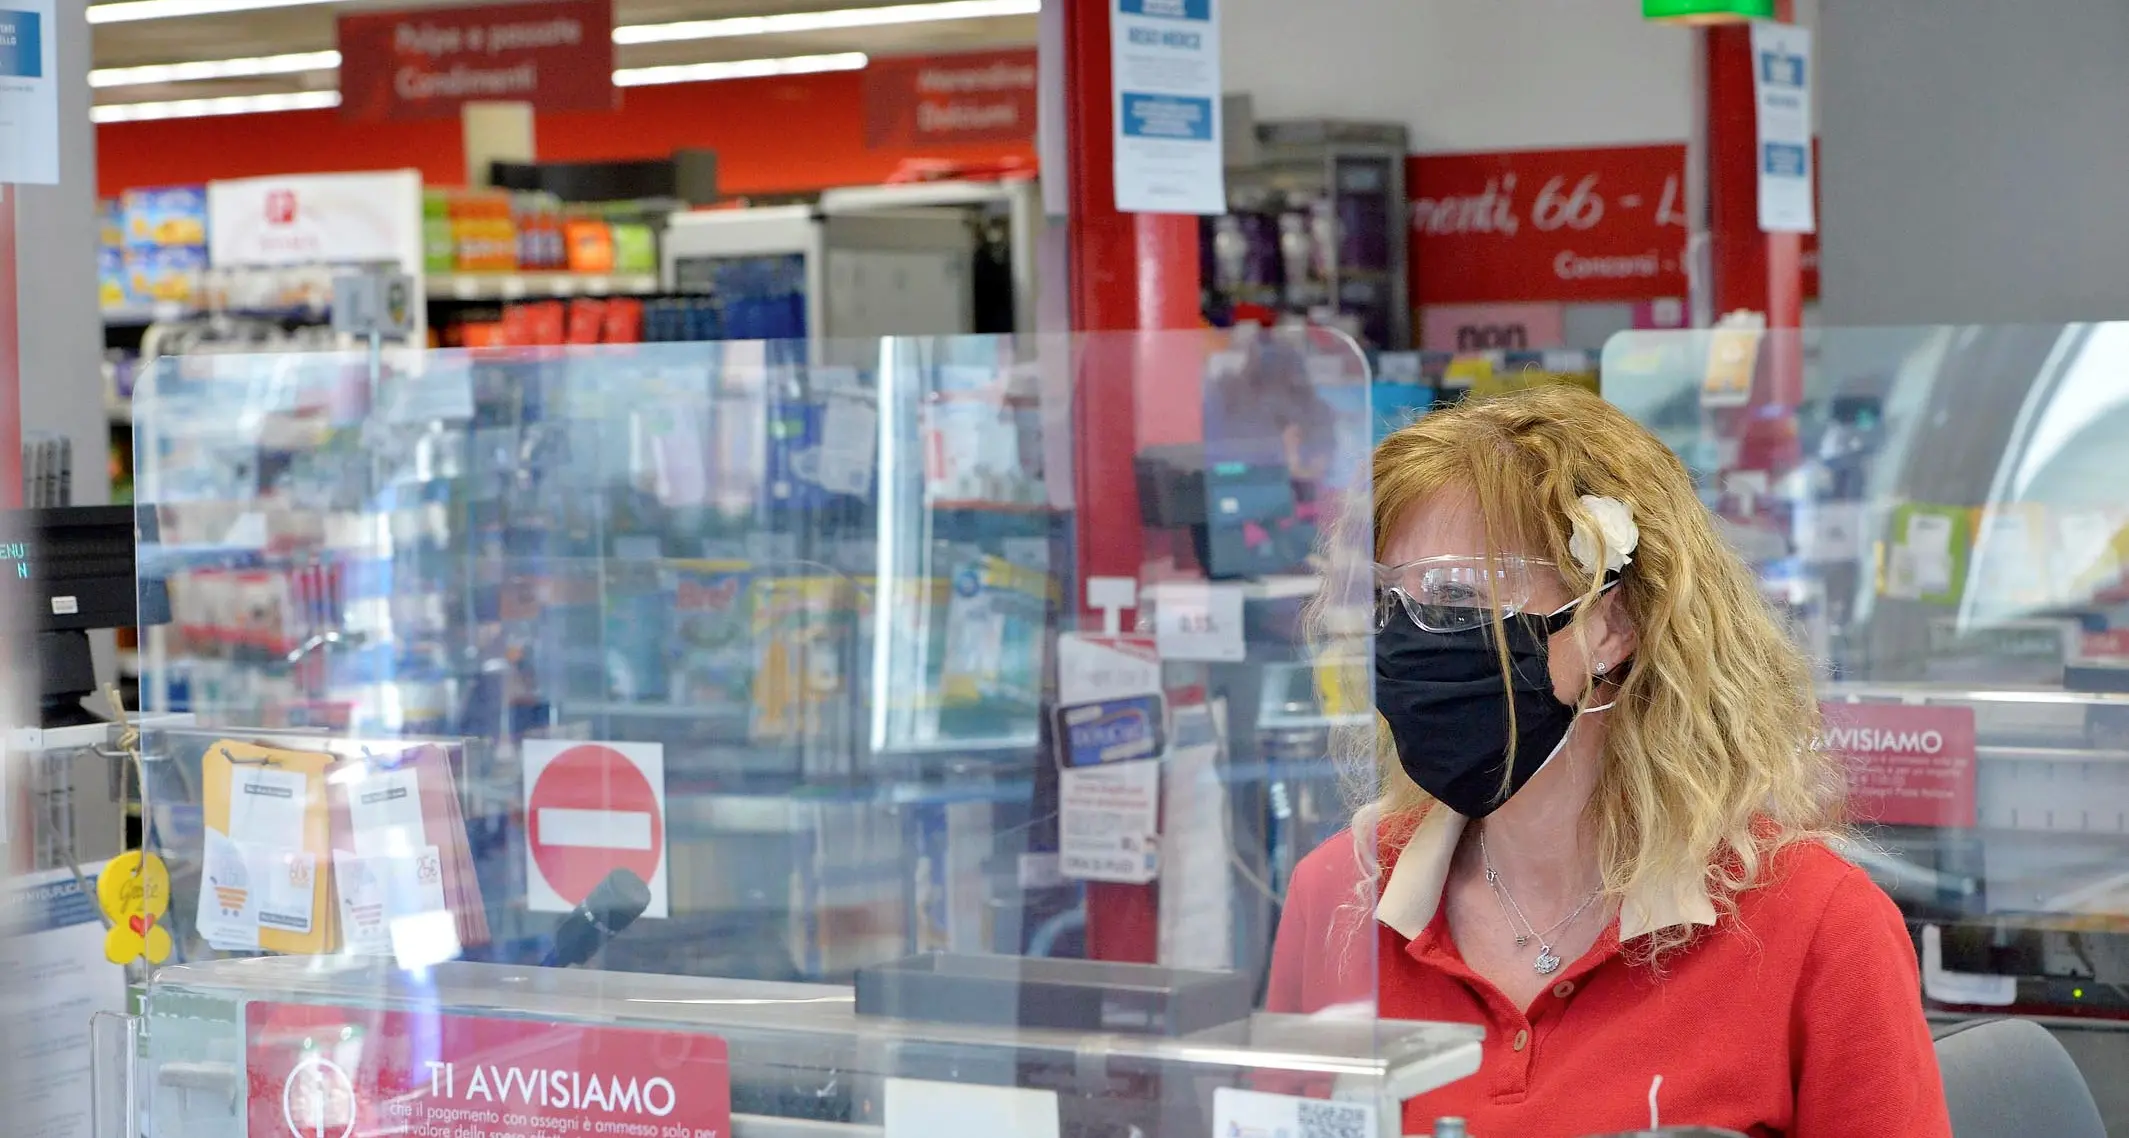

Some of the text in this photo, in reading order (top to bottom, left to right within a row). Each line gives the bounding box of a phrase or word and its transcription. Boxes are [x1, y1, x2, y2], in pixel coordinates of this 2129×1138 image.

[1531, 174, 1604, 232] 66
[1813, 726, 1943, 754] VVISIAMO
[425, 1060, 676, 1117] TI AVVISIAMO
[389, 1100, 413, 1117] che
[416, 1103, 423, 1117] il
[427, 1106, 499, 1123] pagamento
[503, 1112, 527, 1126] con
[530, 1114, 579, 1133] assegni
[595, 1122, 658, 1137] ammesso
[662, 1122, 689, 1138] solo
[694, 1128, 717, 1138] per
[401, 1119, 408, 1134] il
[412, 1121, 450, 1138] valore
[454, 1125, 485, 1138] della
